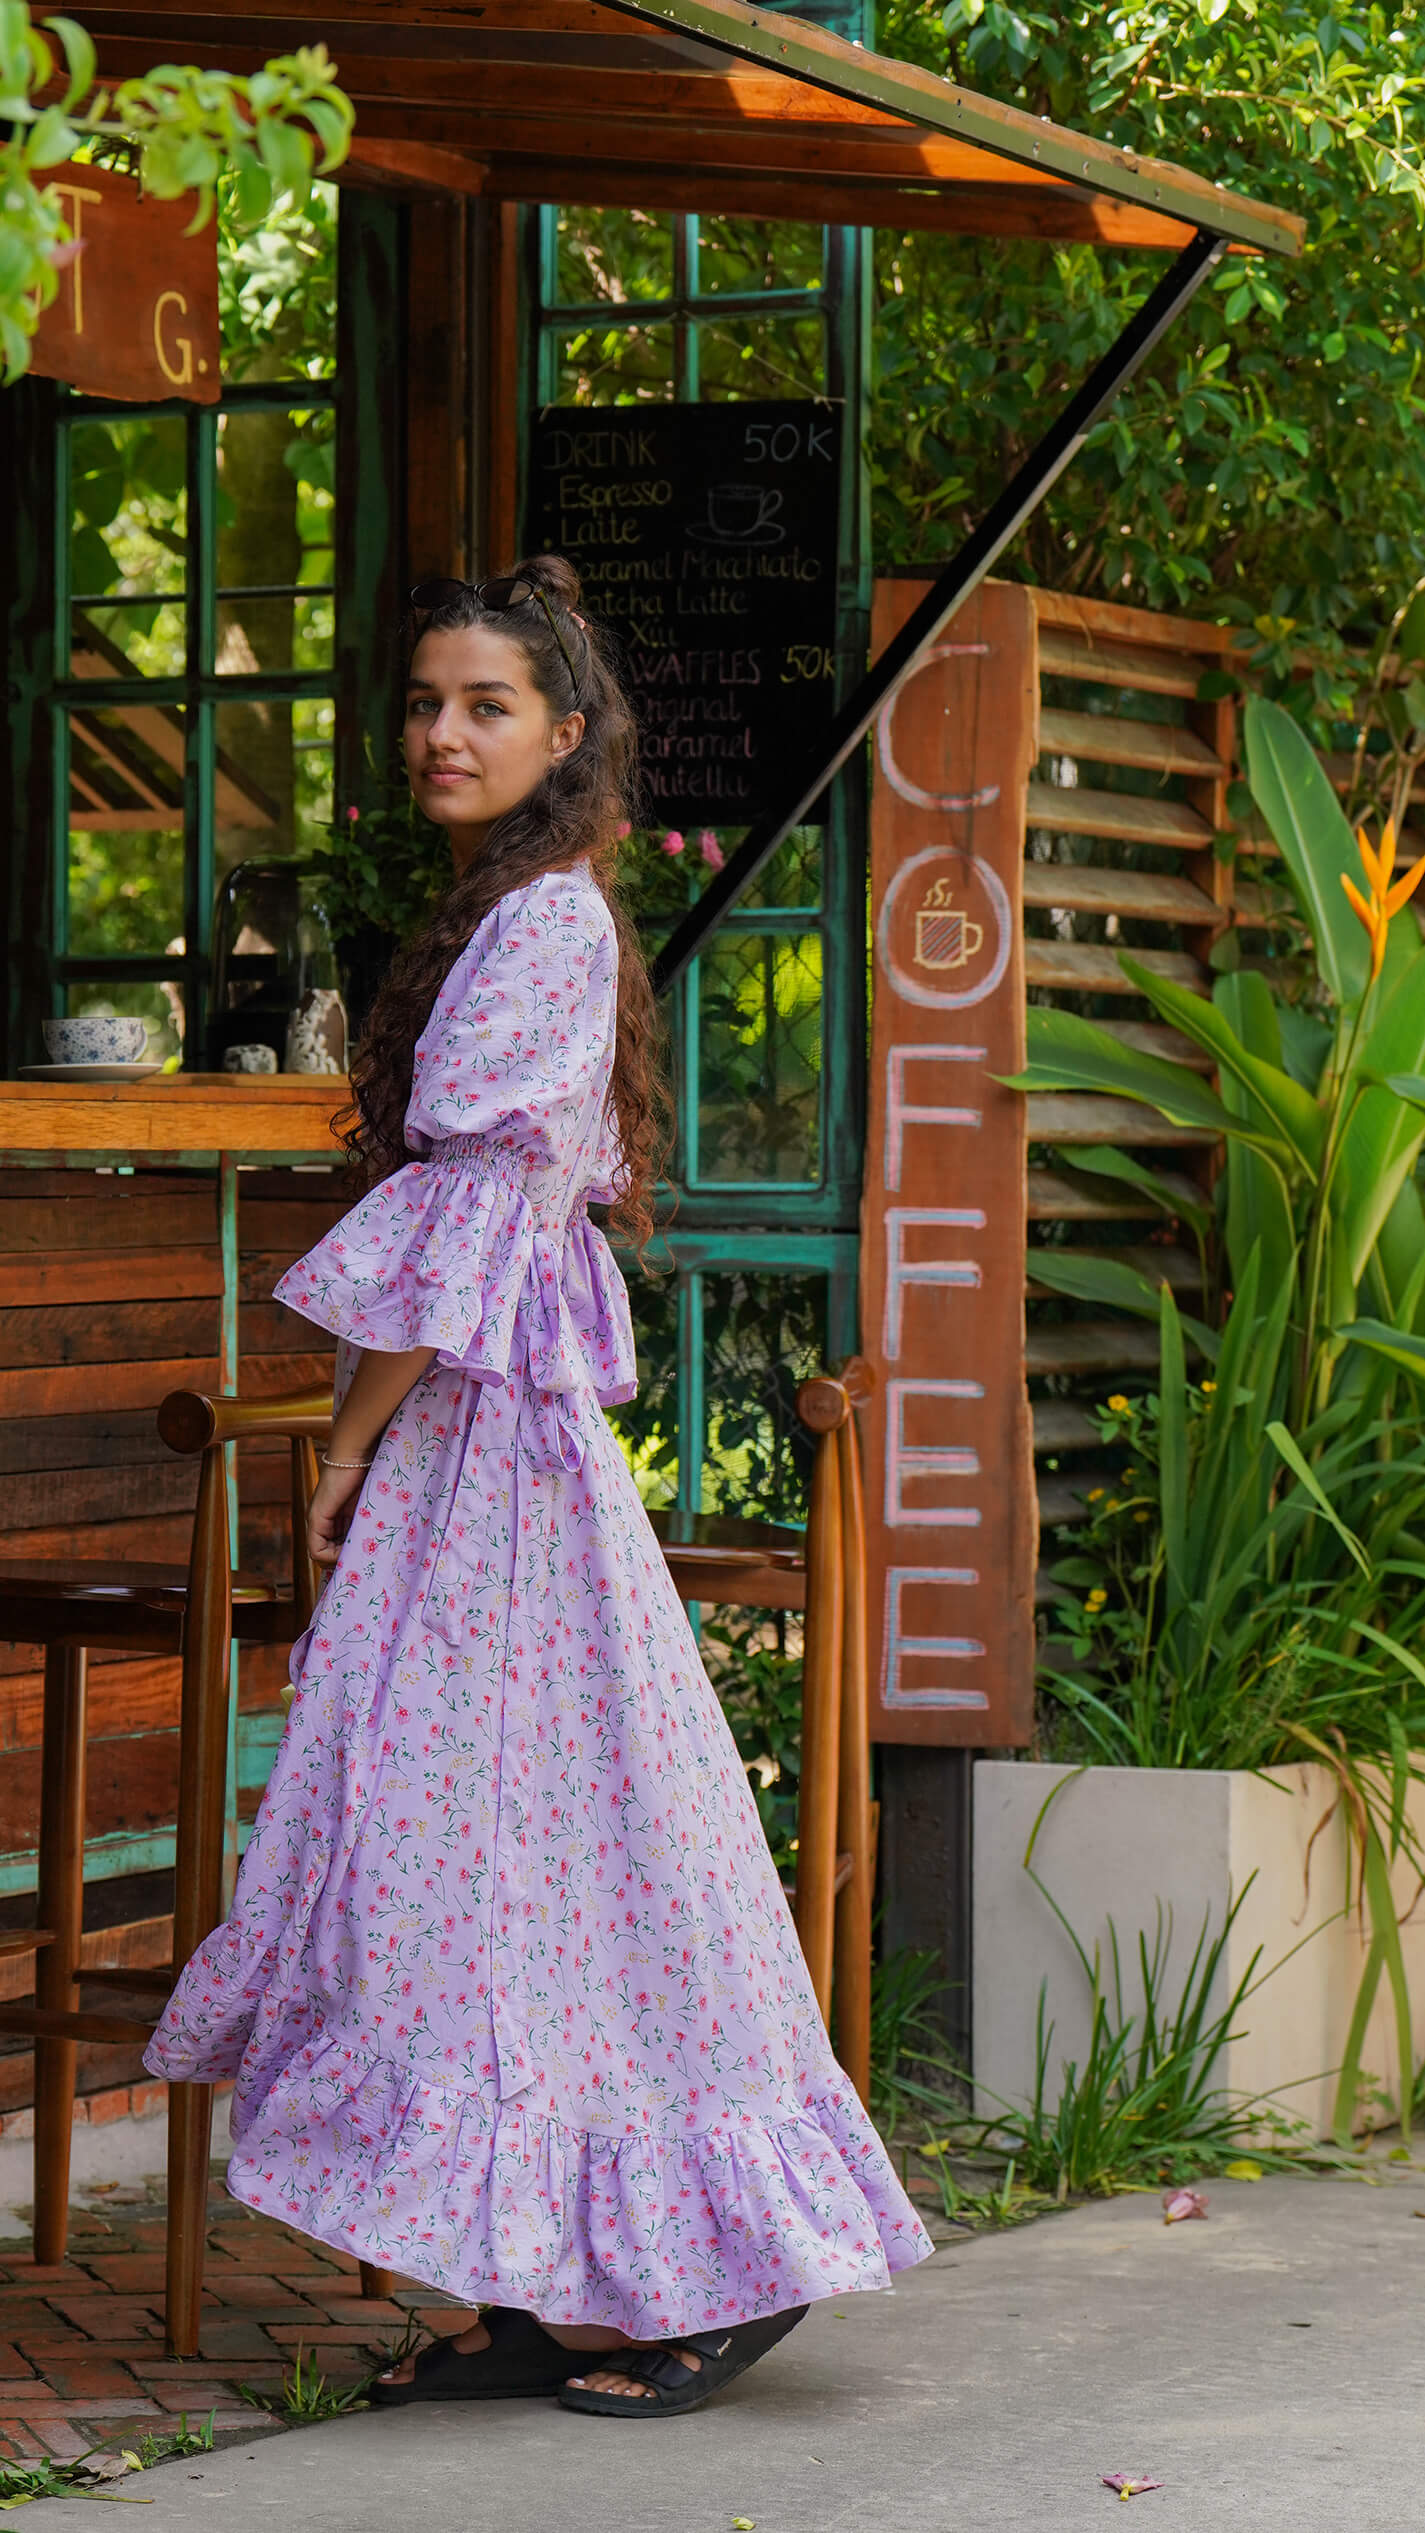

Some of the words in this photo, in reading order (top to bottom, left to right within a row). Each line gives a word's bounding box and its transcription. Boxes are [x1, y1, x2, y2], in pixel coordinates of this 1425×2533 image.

[543, 430, 656, 470] DRINK
[560, 474, 673, 519] Espresso
[560, 514, 643, 548] Latte
[579, 585, 665, 616] atcha
[675, 584, 751, 616] Latte
[625, 649, 761, 686] WAFFLES
[639, 727, 758, 760] aramel
[877, 644, 1012, 1711] COFFEE
